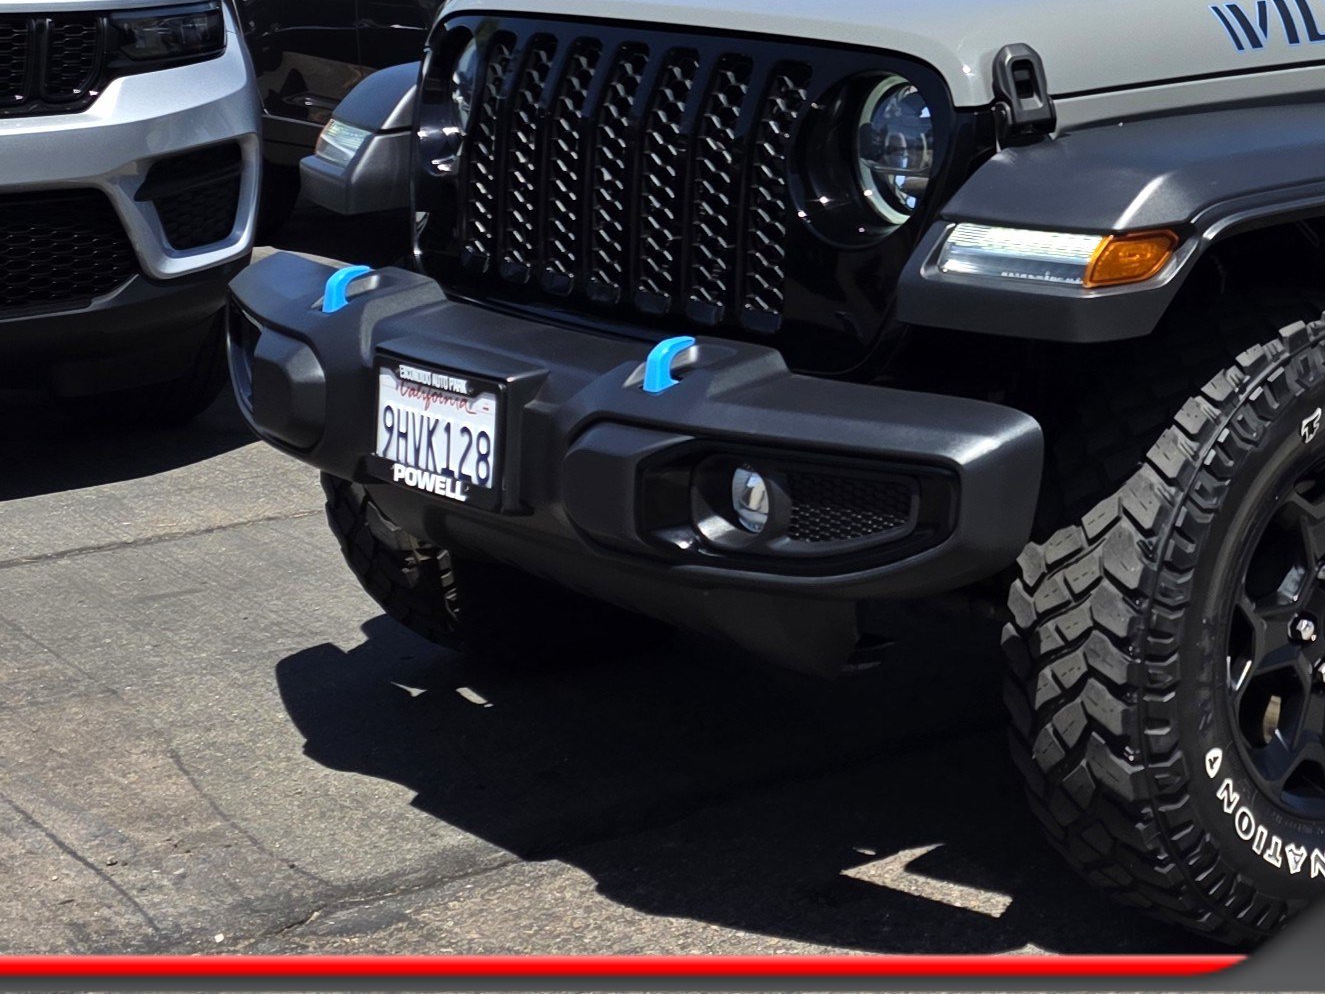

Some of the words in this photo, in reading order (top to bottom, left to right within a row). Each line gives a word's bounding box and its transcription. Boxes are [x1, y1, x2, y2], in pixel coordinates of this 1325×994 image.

[396, 377, 477, 414] California
[382, 404, 491, 488] 9HVK128
[393, 463, 466, 502] POWELL
